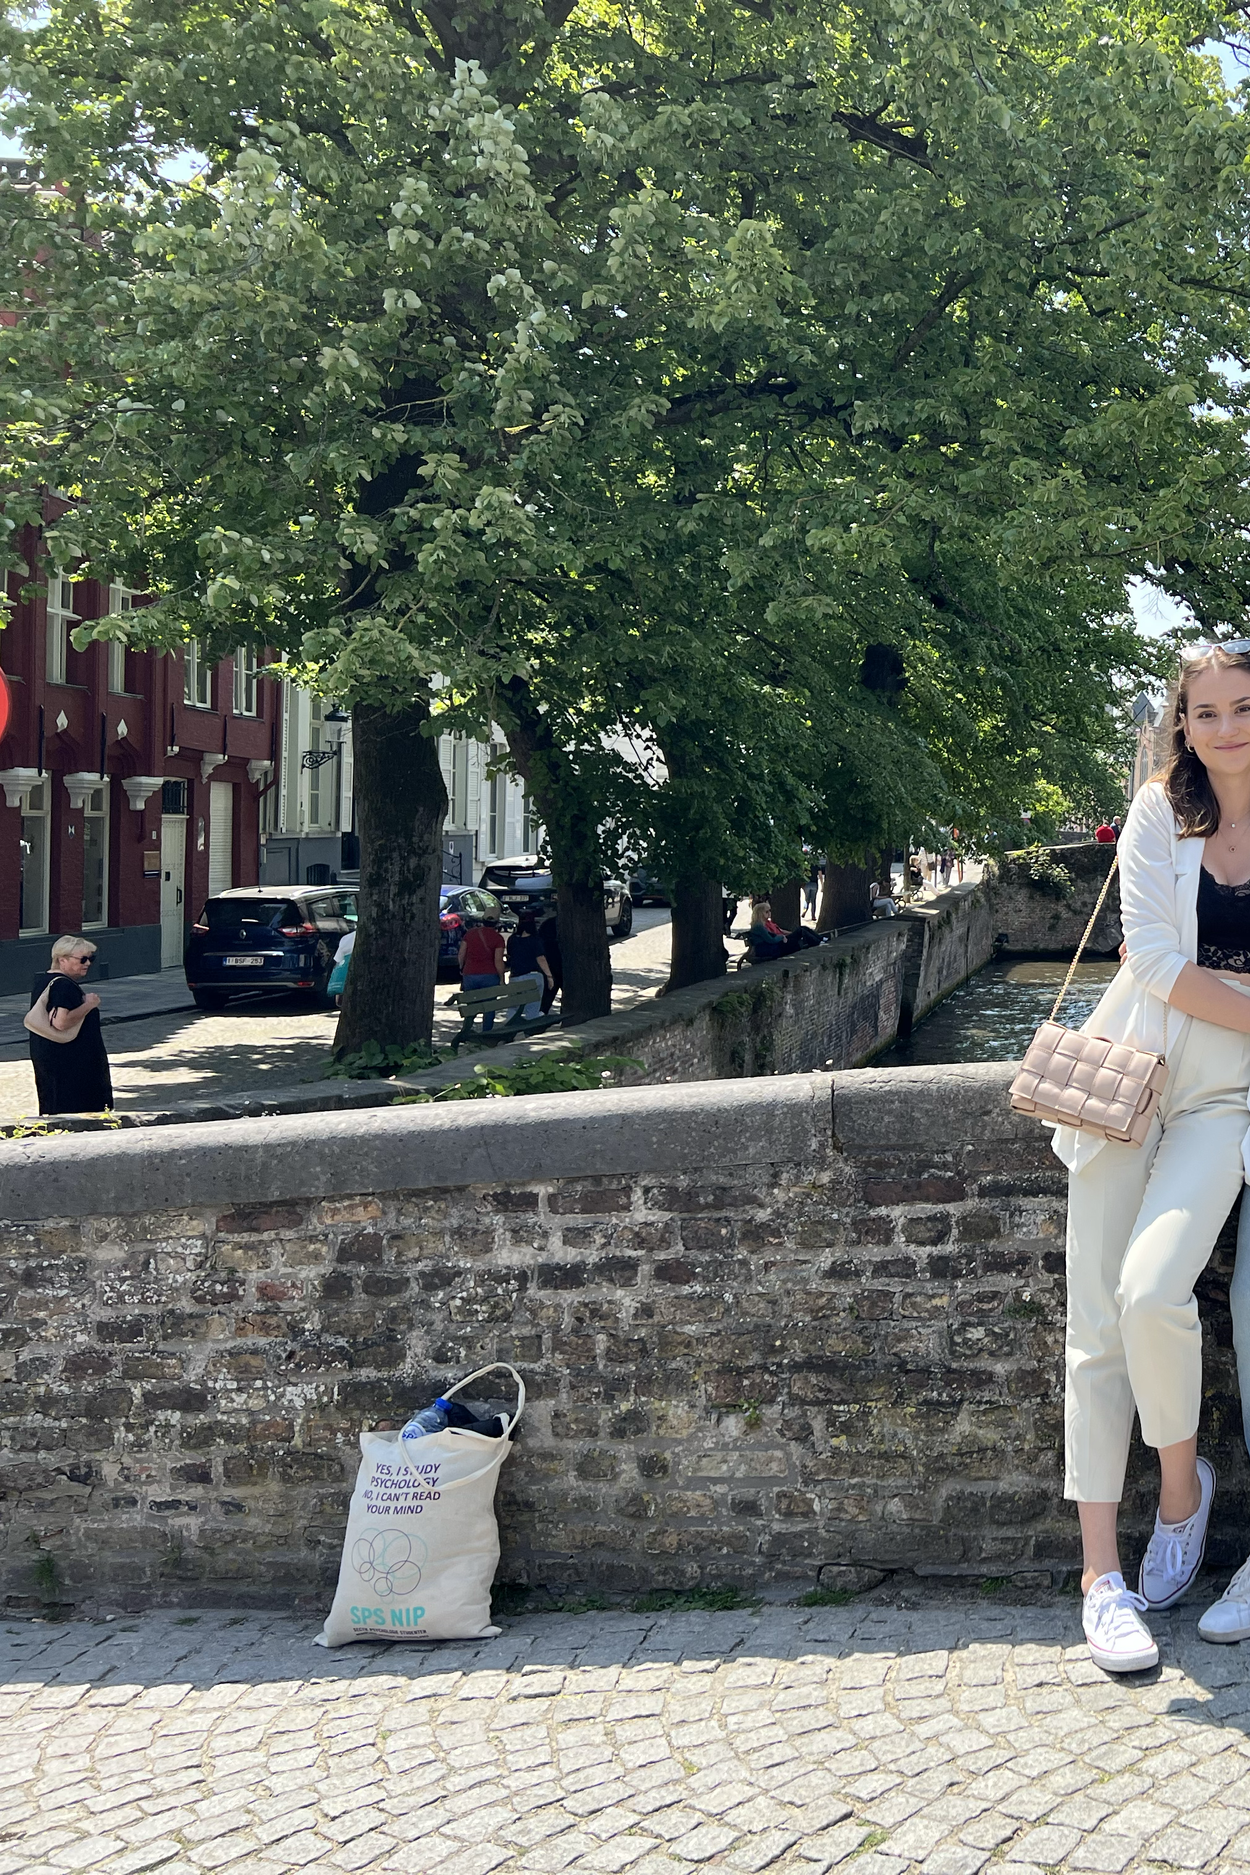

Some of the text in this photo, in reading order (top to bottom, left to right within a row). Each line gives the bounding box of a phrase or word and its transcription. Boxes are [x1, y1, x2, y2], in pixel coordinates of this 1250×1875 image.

[375, 1462, 393, 1477] YES,
[396, 1466, 402, 1476] I
[362, 1489, 441, 1502] NO, I CAN'T READ
[366, 1503, 424, 1515] YOUR MIND
[350, 1606, 425, 1627] SPS NIP
